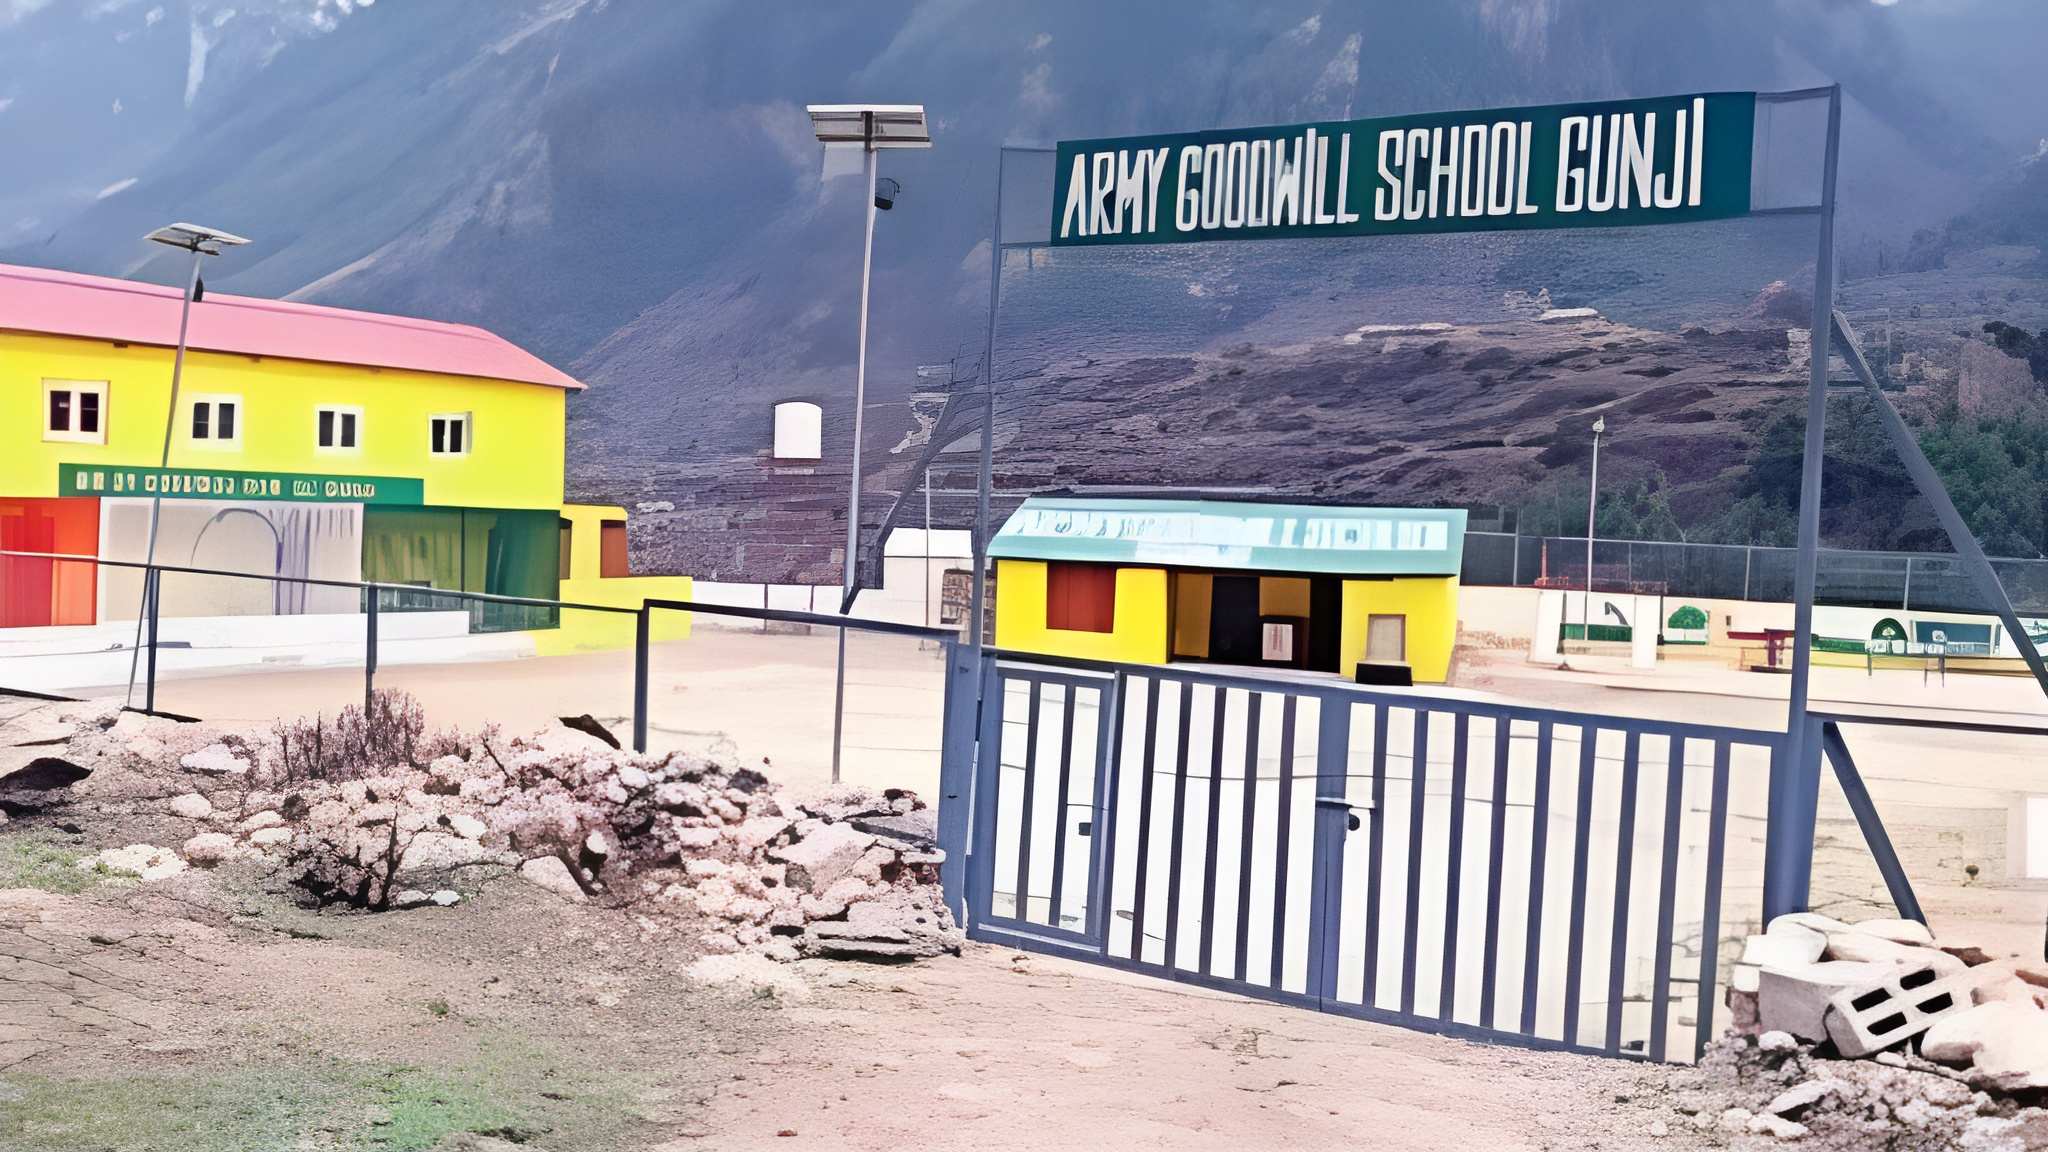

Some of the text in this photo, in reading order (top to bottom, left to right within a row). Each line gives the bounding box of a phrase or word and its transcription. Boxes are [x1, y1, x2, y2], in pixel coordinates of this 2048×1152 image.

[1060, 98, 1705, 237] ARMY GOODWILL SCHOOL GUNJI
